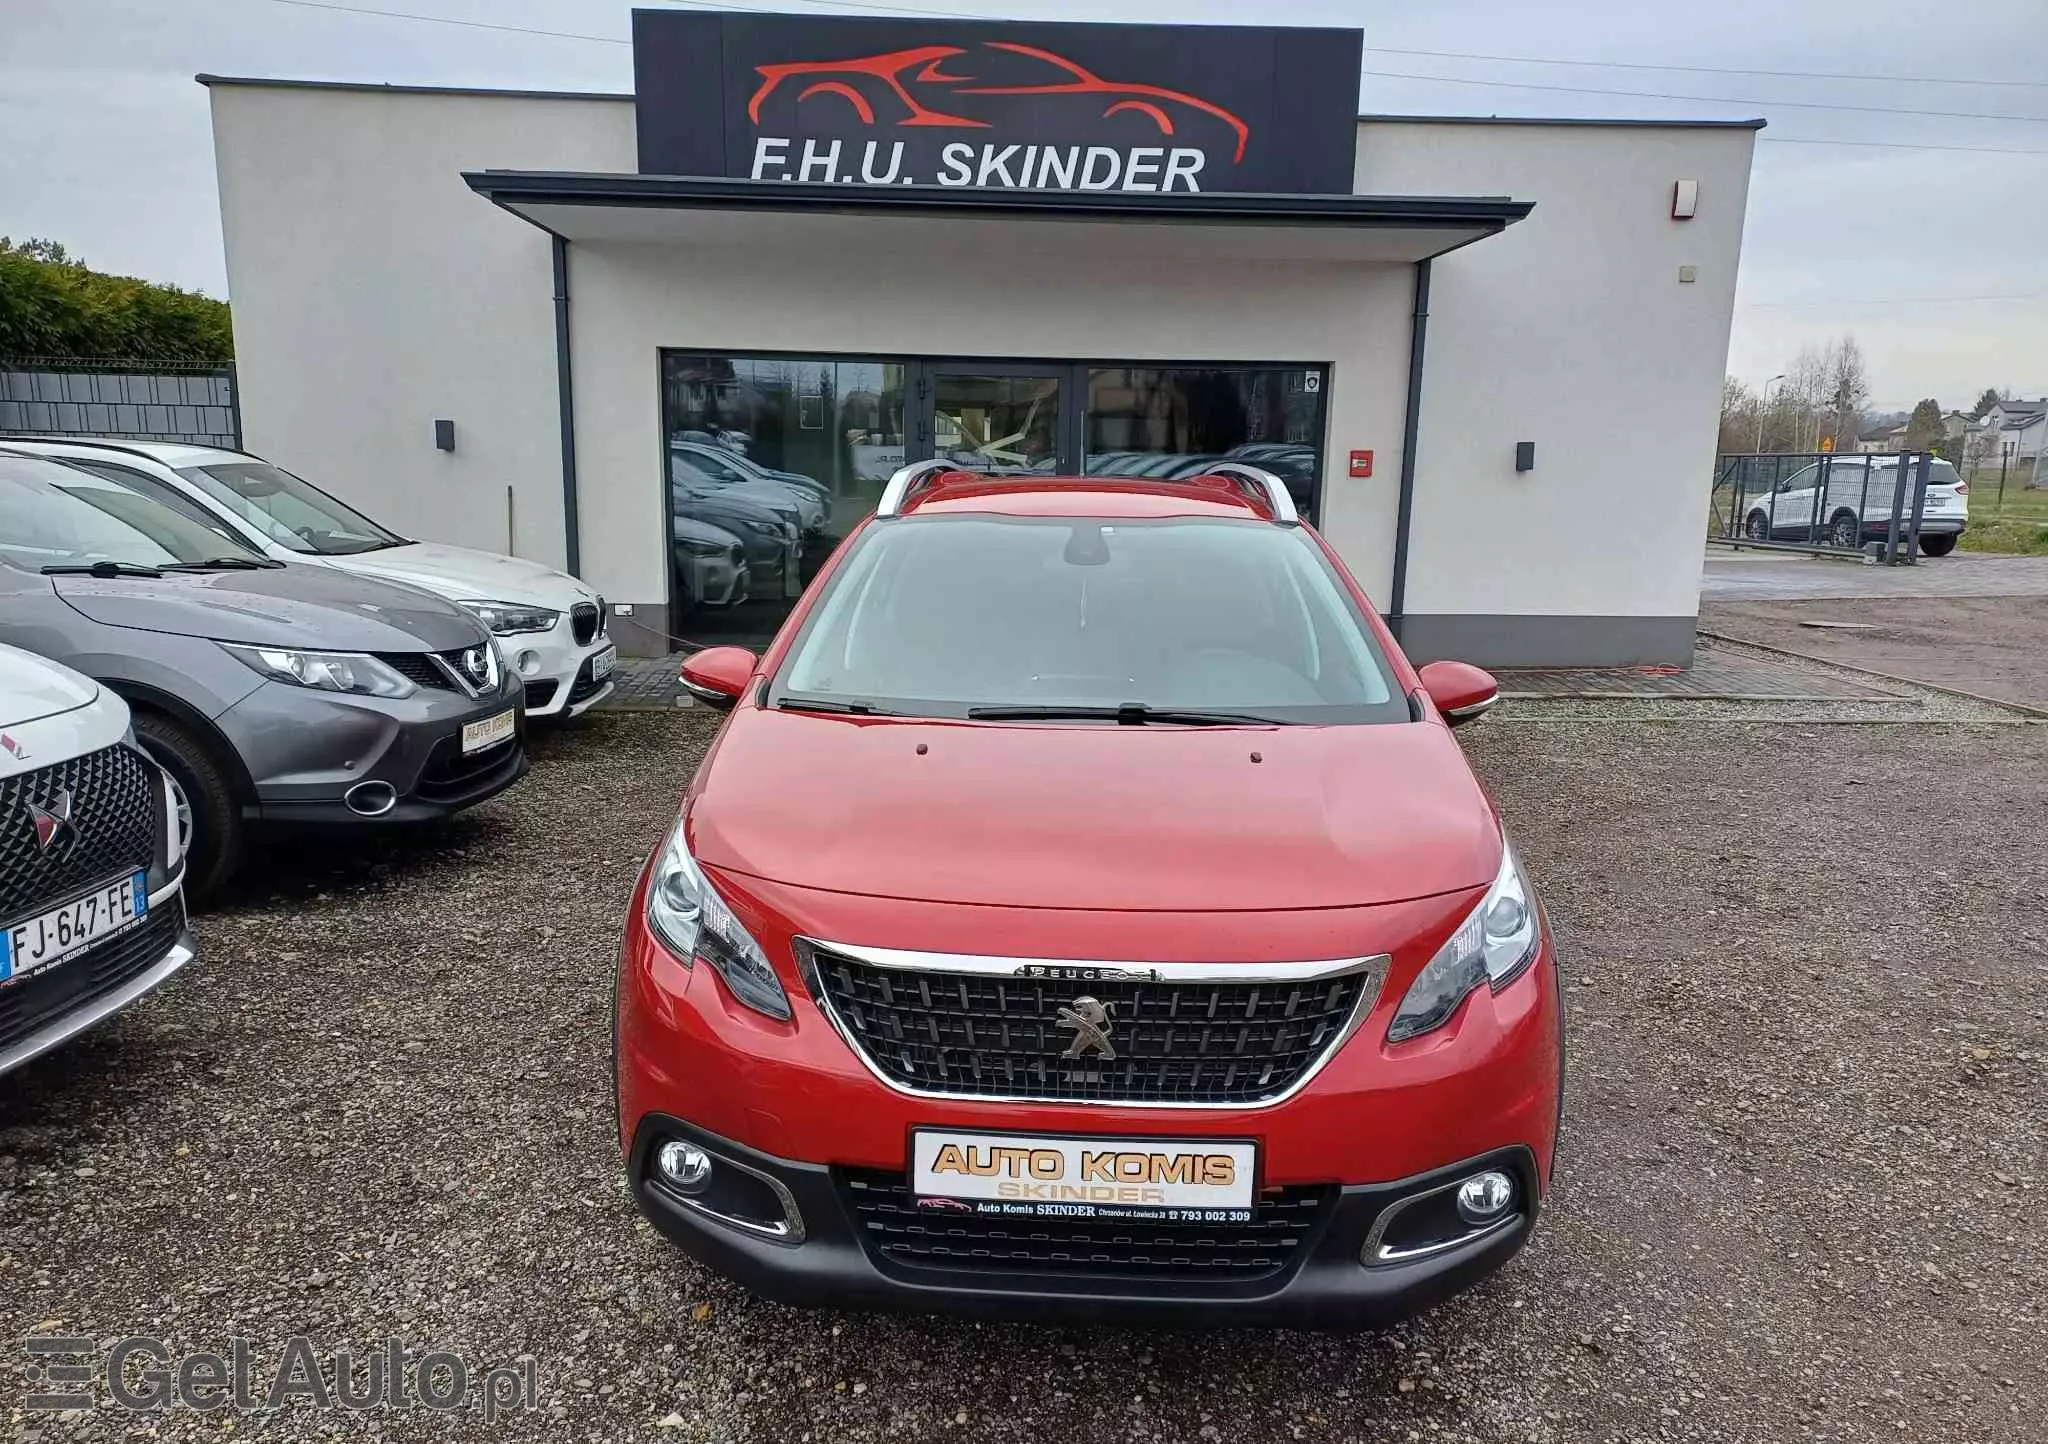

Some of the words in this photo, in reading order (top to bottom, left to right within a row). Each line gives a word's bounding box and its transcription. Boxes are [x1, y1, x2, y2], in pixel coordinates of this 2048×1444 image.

[751, 137, 914, 185] F.H.U.
[936, 142, 1207, 193] SKINDER
[12, 880, 132, 969] FJ-647-FE
[1030, 966, 1146, 980] PEUGEO
[932, 1144, 1065, 1181] AUTO
[1081, 1150, 1236, 1186] KOMIS
[997, 1181, 1165, 1203] SKINDER
[977, 1202, 1001, 1213] Auto
[1003, 1203, 1034, 1214] Komis
[1036, 1204, 1096, 1217] SKINDER
[1181, 1210, 1202, 1220] 793
[1204, 1211, 1226, 1221] 002
[1229, 1211, 1250, 1222] 309
